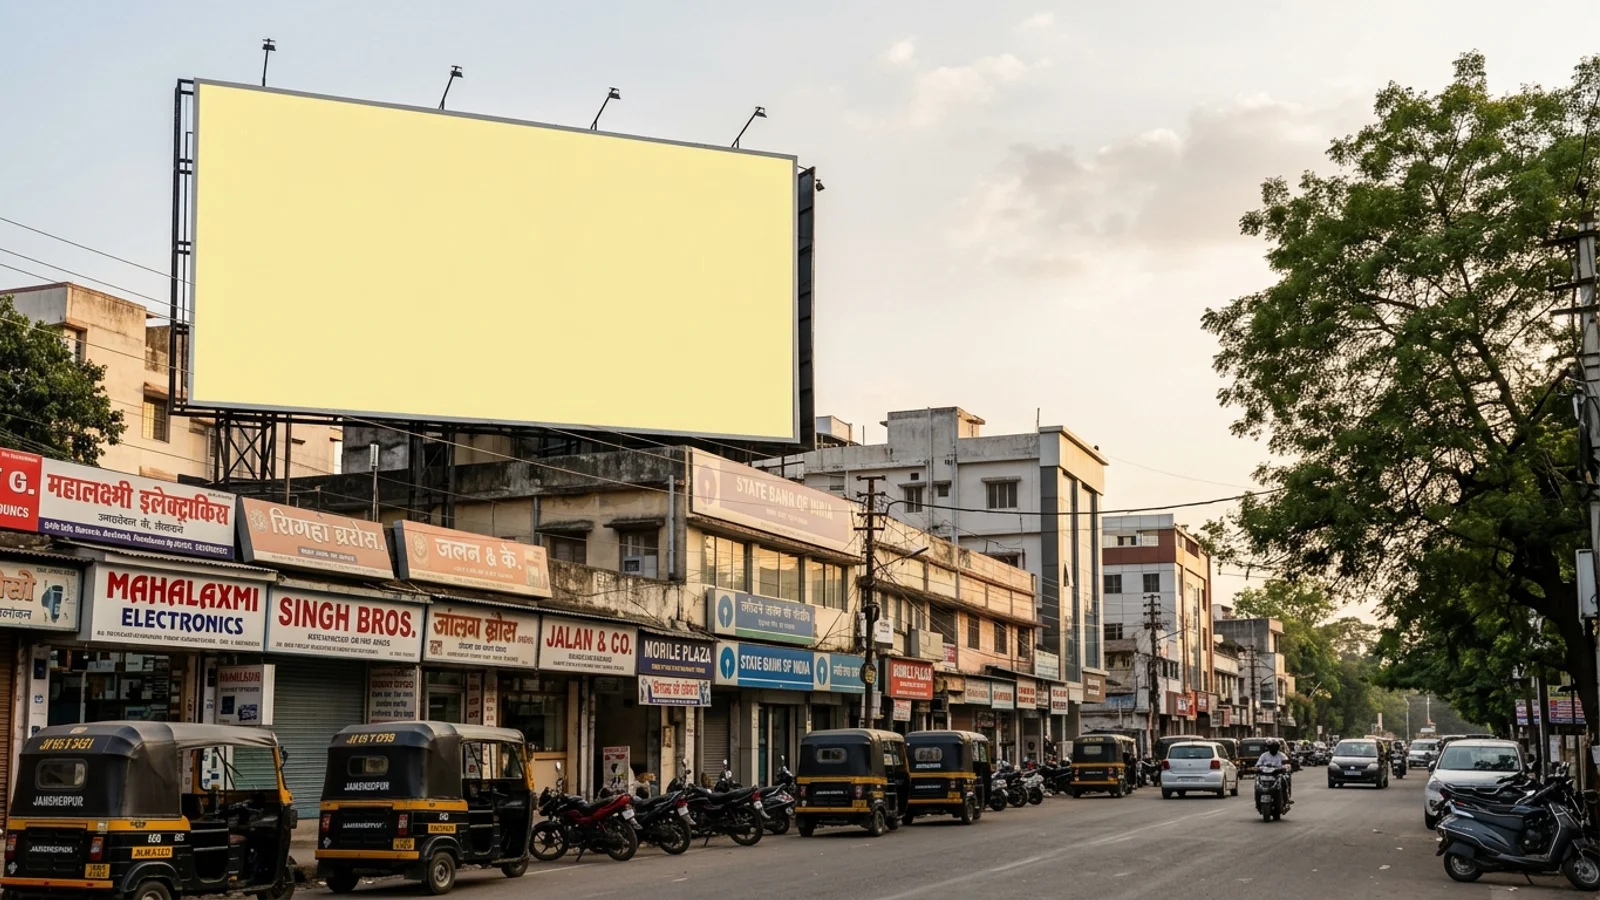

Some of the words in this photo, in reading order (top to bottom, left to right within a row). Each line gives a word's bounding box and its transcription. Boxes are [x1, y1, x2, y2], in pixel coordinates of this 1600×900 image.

[9, 470, 35, 495] G.
[736, 476, 767, 500] STATE
[434, 538, 481, 563] जलन
[486, 547, 497, 567] &
[106, 571, 259, 612] MAHALAXMI
[121, 607, 244, 635] ELECTRONICS
[278, 597, 350, 631] SINGH
[357, 606, 416, 638] BROS.
[546, 625, 593, 651] JALAN
[597, 630, 606, 652] &
[611, 632, 632, 655] CO.
[682, 645, 711, 663] PLAZA
